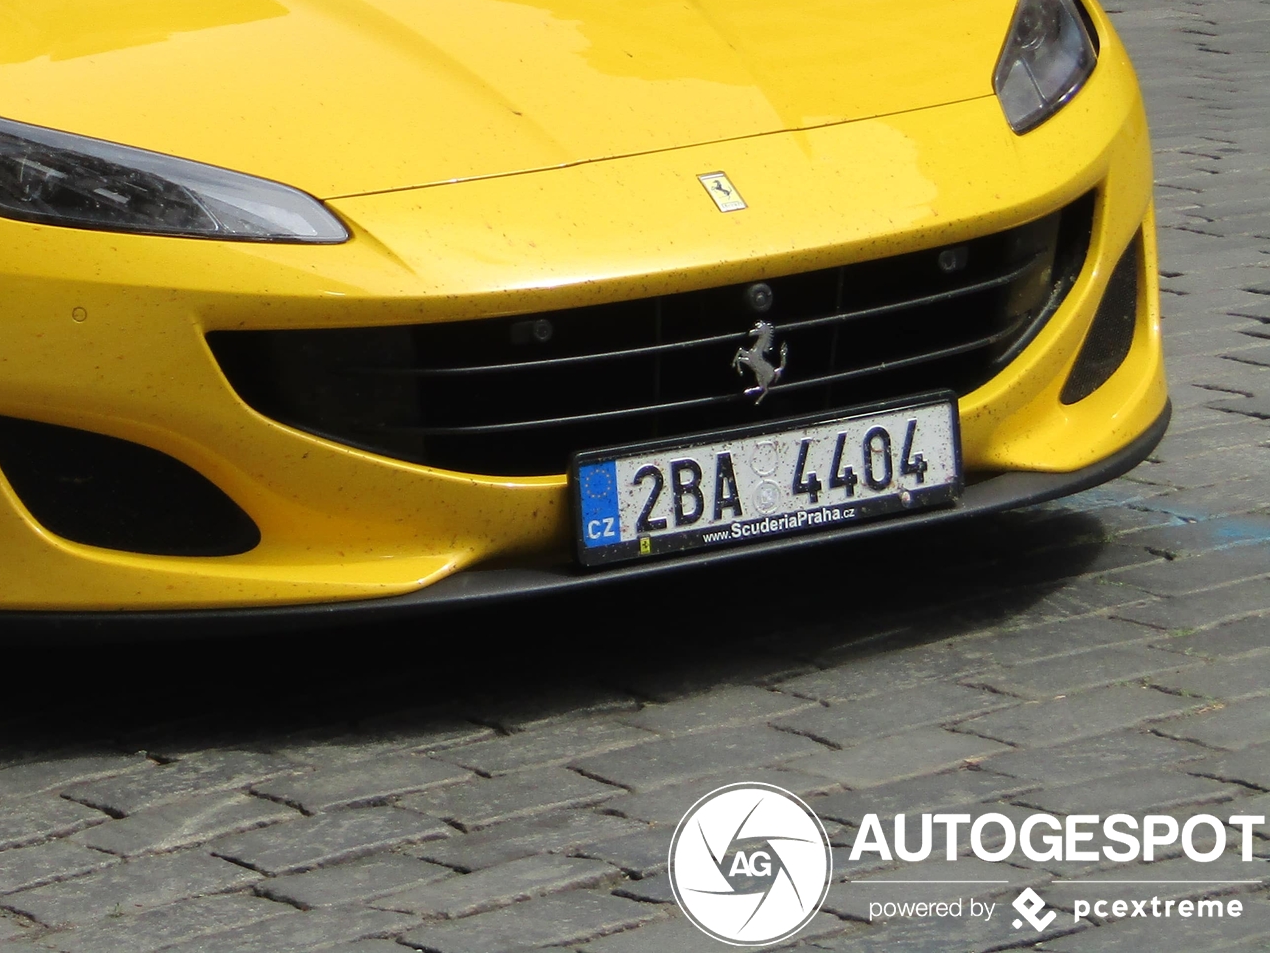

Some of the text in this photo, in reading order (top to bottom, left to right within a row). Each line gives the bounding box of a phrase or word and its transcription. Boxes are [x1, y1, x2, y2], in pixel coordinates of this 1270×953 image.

[633, 418, 929, 533] 2BA 4404
[587, 517, 616, 540] CZ
[702, 507, 856, 544] www.ScuderiaPraha.cz
